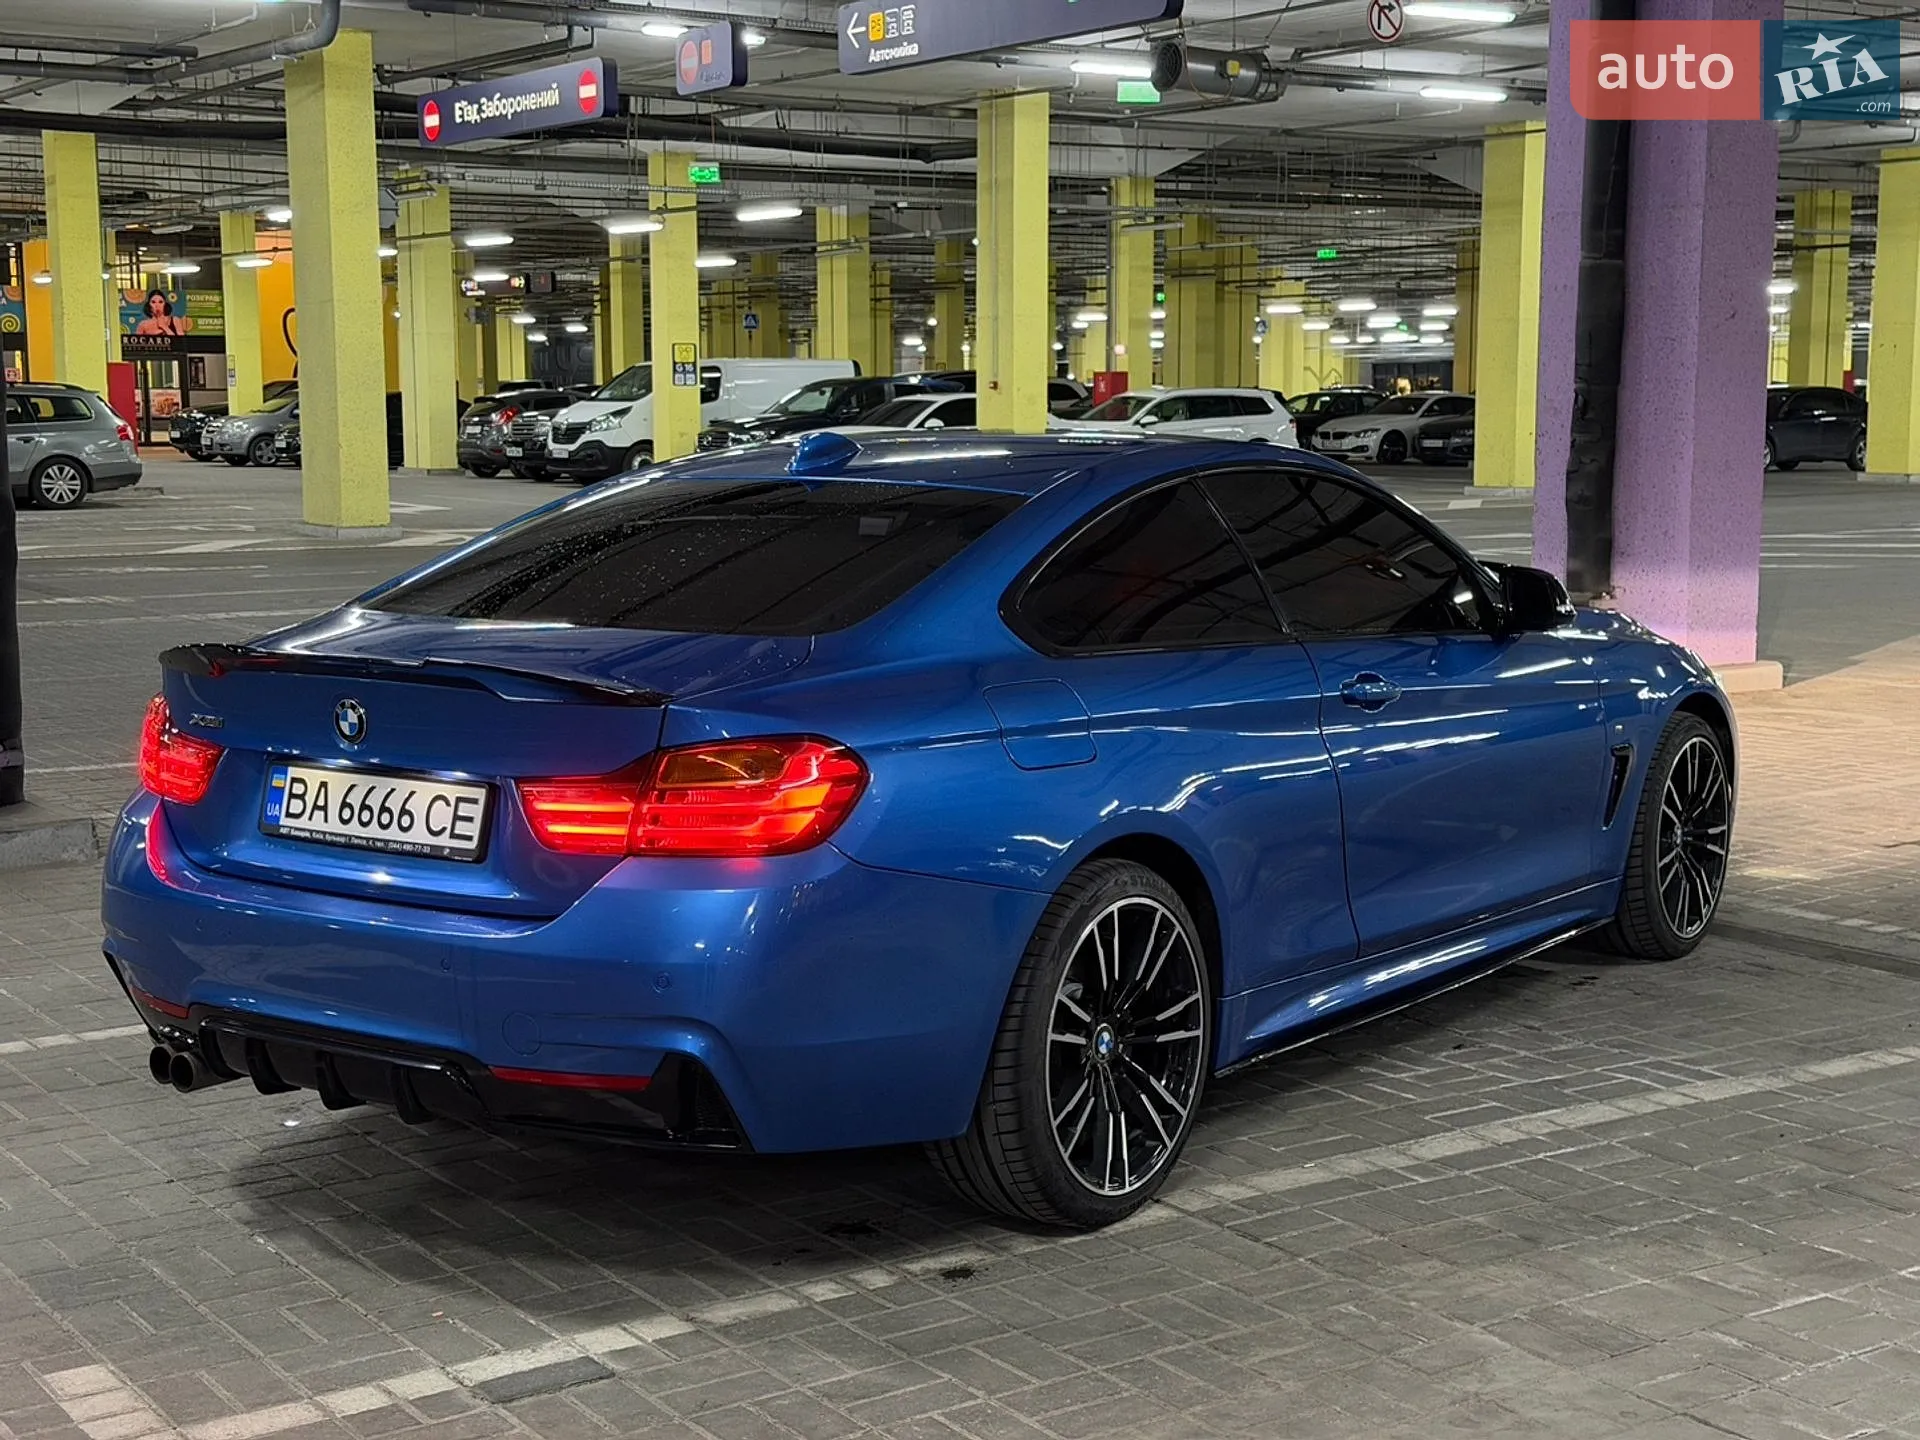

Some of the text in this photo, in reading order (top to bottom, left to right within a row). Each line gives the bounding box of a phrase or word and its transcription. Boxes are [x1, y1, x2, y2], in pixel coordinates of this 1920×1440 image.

[480, 82, 560, 120] Заборонений
[267, 802, 280, 816] UA
[285, 777, 479, 841] BA 6666 CE
